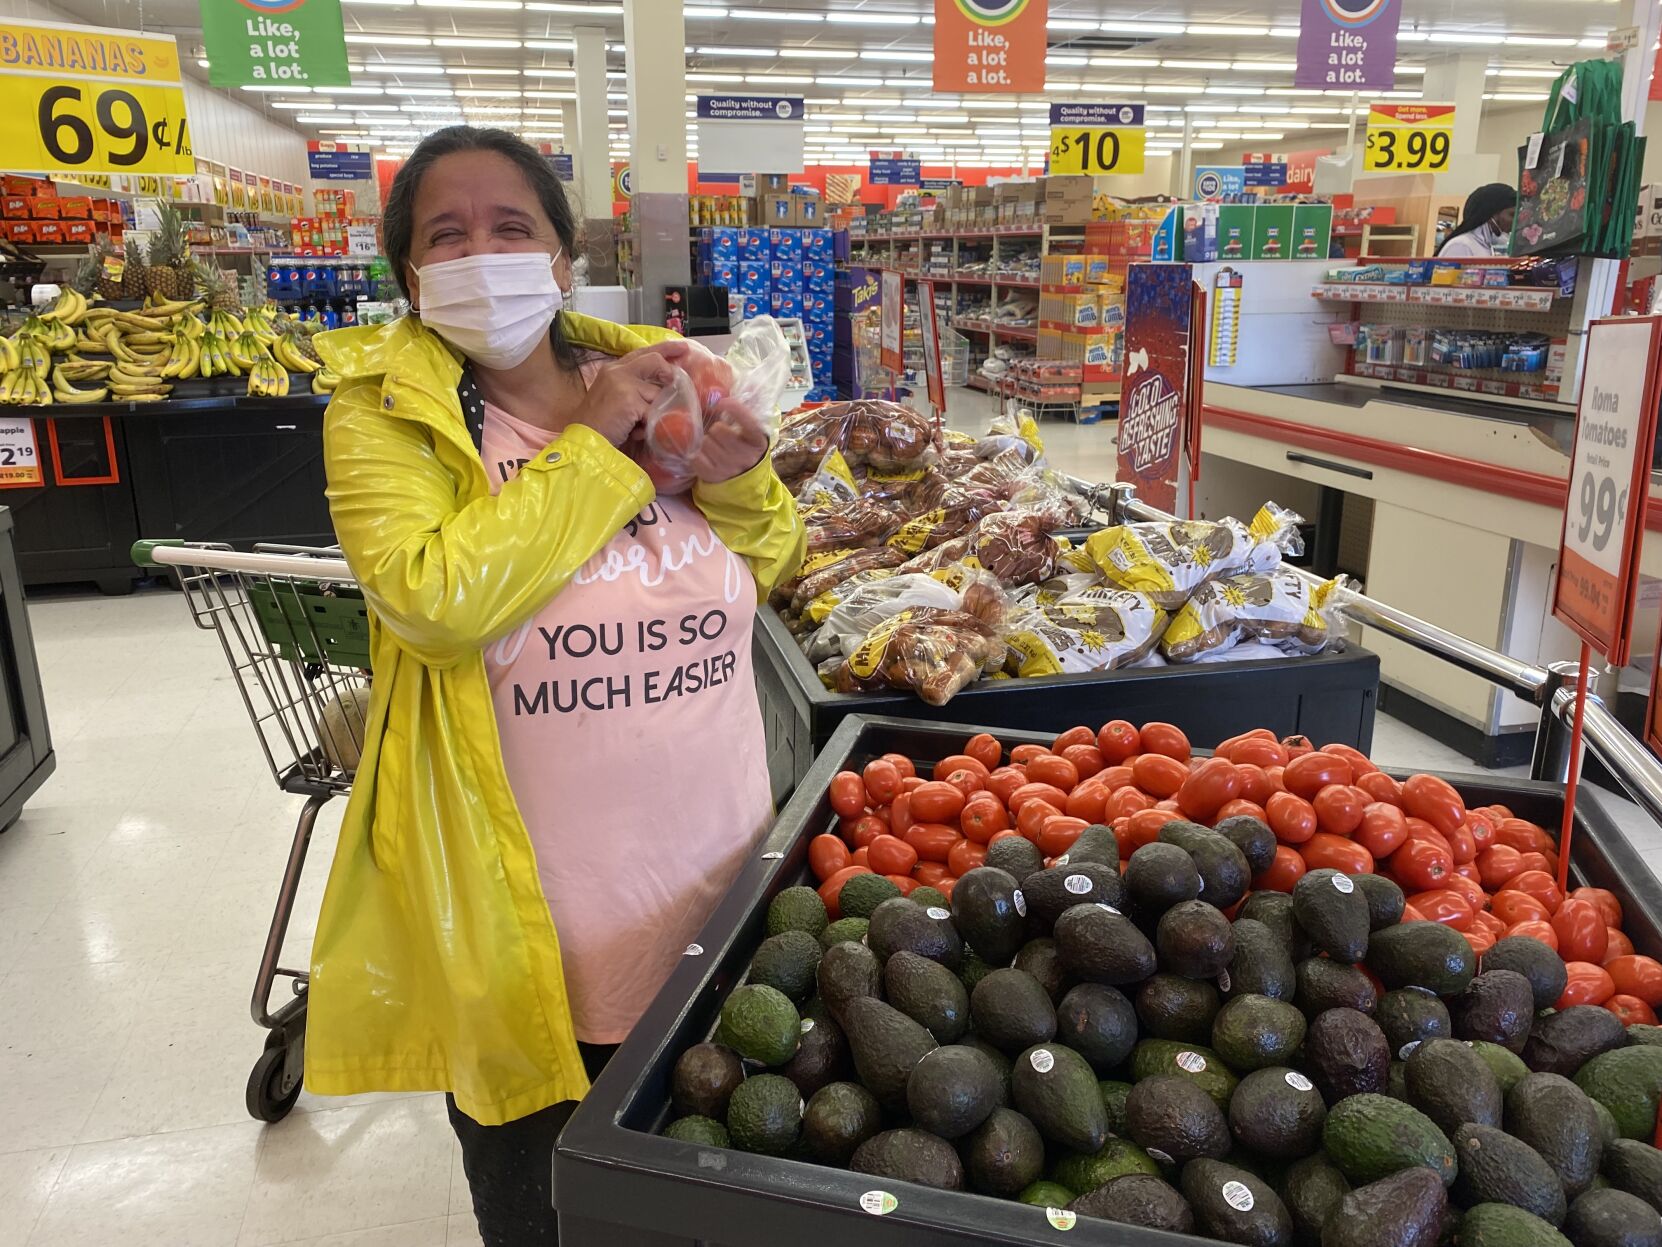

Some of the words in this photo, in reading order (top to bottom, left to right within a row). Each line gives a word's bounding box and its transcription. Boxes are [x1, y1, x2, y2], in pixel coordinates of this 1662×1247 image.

[246, 16, 300, 41] Like,
[968, 28, 1010, 51] Like,
[1330, 30, 1368, 51] Like,
[0, 32, 146, 75] BANANAS
[250, 44, 264, 58] a
[267, 41, 300, 58] lot
[967, 52, 978, 65] a
[982, 50, 1007, 66] lot
[1328, 53, 1338, 65] a
[1341, 50, 1364, 65] lot
[252, 65, 267, 79] a
[270, 62, 308, 79] lot.
[967, 71, 978, 84] a
[982, 69, 1011, 85] lot.
[1326, 70, 1336, 82] a
[1339, 68, 1366, 83] lot.
[710, 99, 740, 109] Quality
[741, 100, 773, 109] without
[1060, 107, 1089, 116] Quality
[1089, 107, 1116, 115] without
[710, 109, 763, 117] compromise.
[1060, 115, 1107, 123] compromise.
[356, 144, 360, 152] 1
[559, 146, 564, 154] 2
[1052, 146, 1060, 157] 4
[1367, 130, 1450, 169] $3.99
[1286, 163, 1315, 188] dairy
[852, 281, 879, 308] Takis
[1591, 385, 1620, 414] Roma
[1581, 415, 1628, 449] Tomatoes
[1137, 427, 1171, 467] TASTE
[538, 622, 624, 660] YOU
[638, 619, 668, 653] IS
[679, 609, 727, 646] SO
[514, 674, 631, 716] MUCH
[644, 650, 736, 704] EASIER
